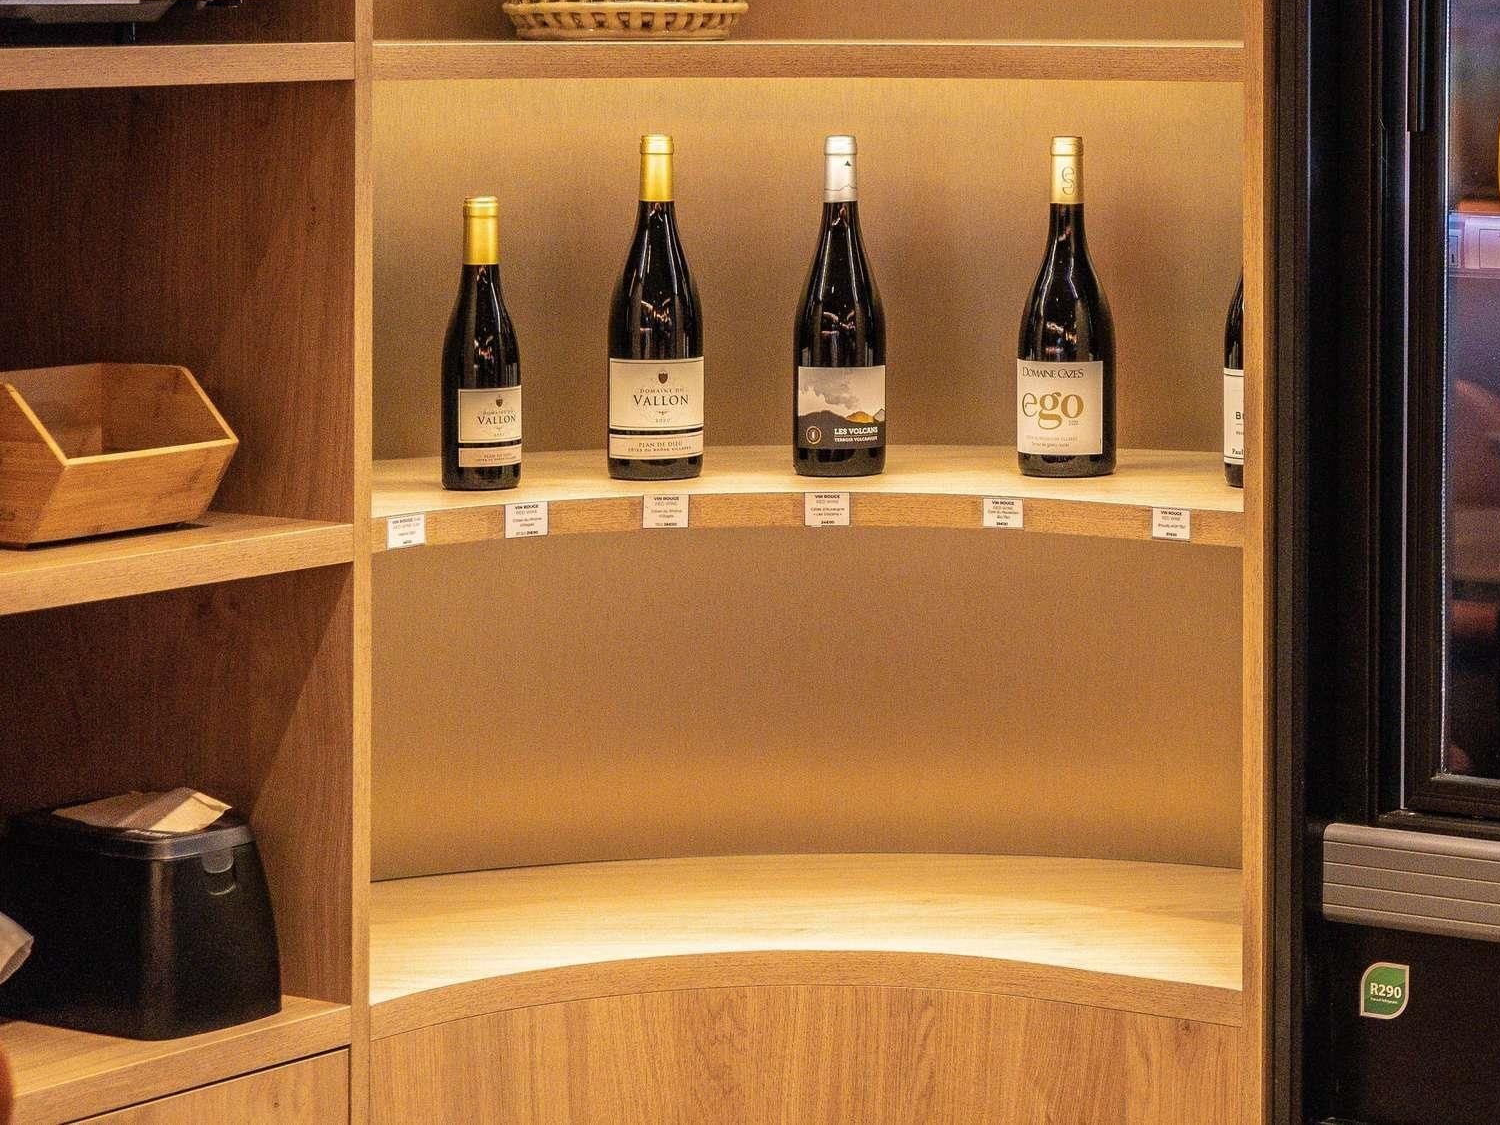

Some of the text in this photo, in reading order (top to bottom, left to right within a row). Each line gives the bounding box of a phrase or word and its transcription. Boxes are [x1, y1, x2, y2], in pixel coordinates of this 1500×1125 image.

[1022, 366, 1084, 379] DOMAINE CAZES
[633, 394, 689, 406] VALLON
[1022, 391, 1084, 430] ego
[477, 414, 517, 425] VALLON
[848, 426, 879, 435] VOLCANS
[1370, 982, 1402, 999] R290
